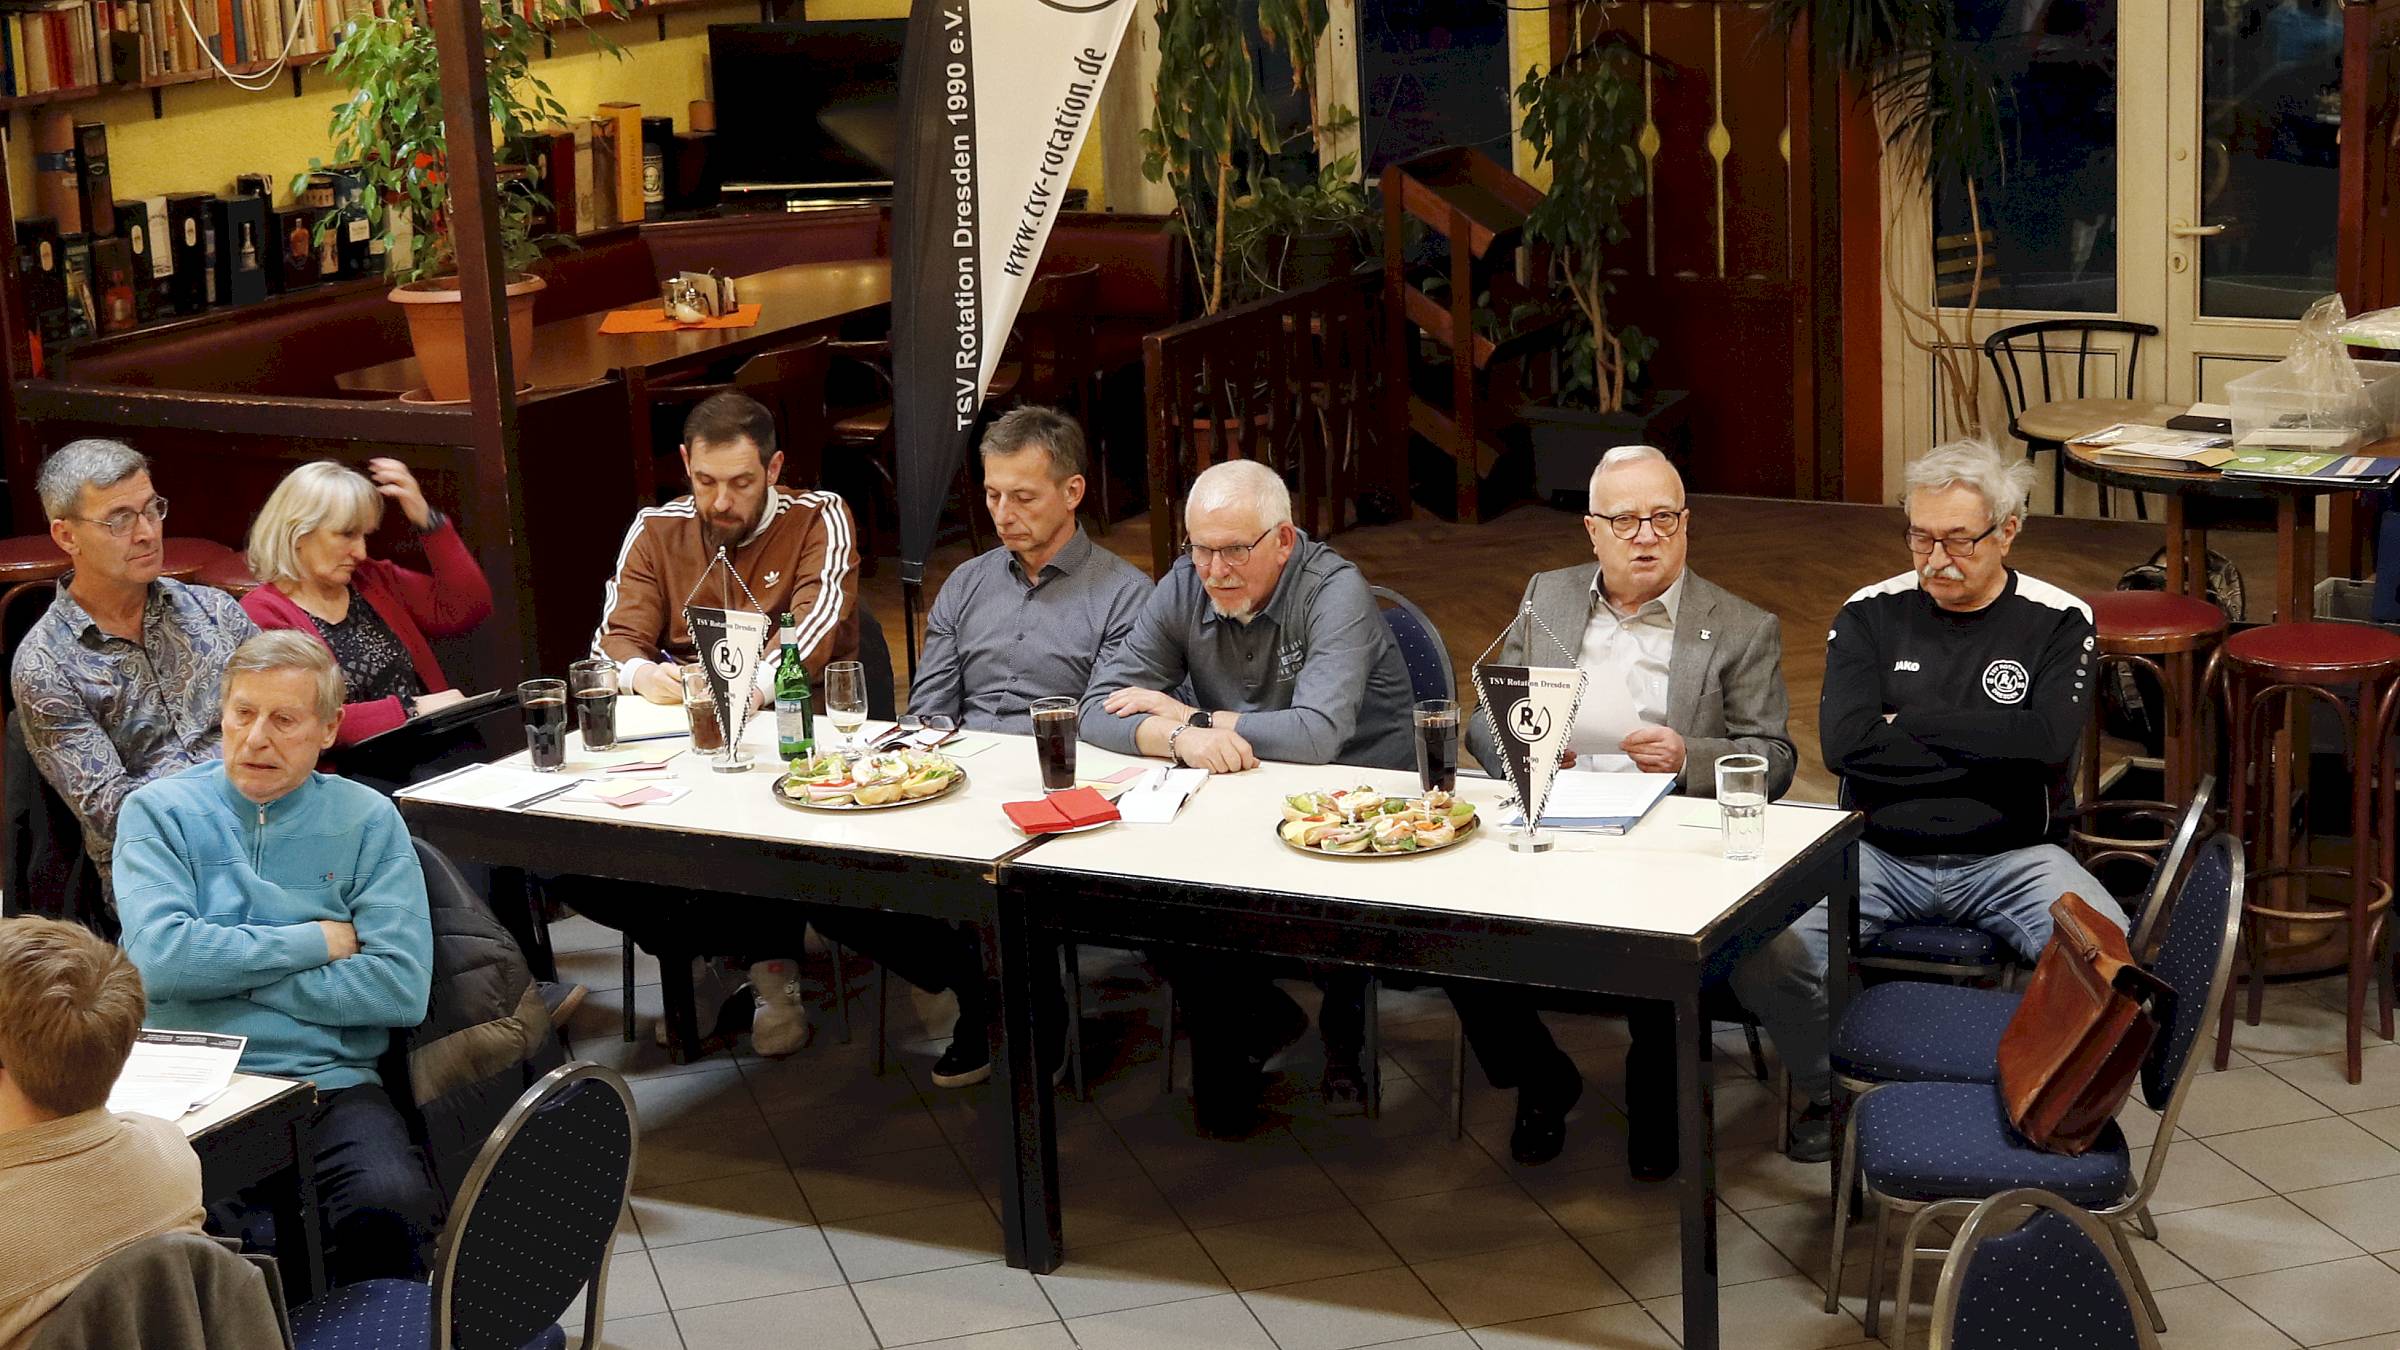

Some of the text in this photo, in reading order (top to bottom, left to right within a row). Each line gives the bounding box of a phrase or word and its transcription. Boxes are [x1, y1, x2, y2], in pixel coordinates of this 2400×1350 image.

[944, 5, 976, 431] TSV Rotation Dresden 1990 e.V.
[1003, 47, 1107, 277] www.tsv-rotation.de
[1488, 677, 1506, 685] TSV
[1540, 679, 1571, 689] Dresden
[1893, 660, 1920, 671] JAKO
